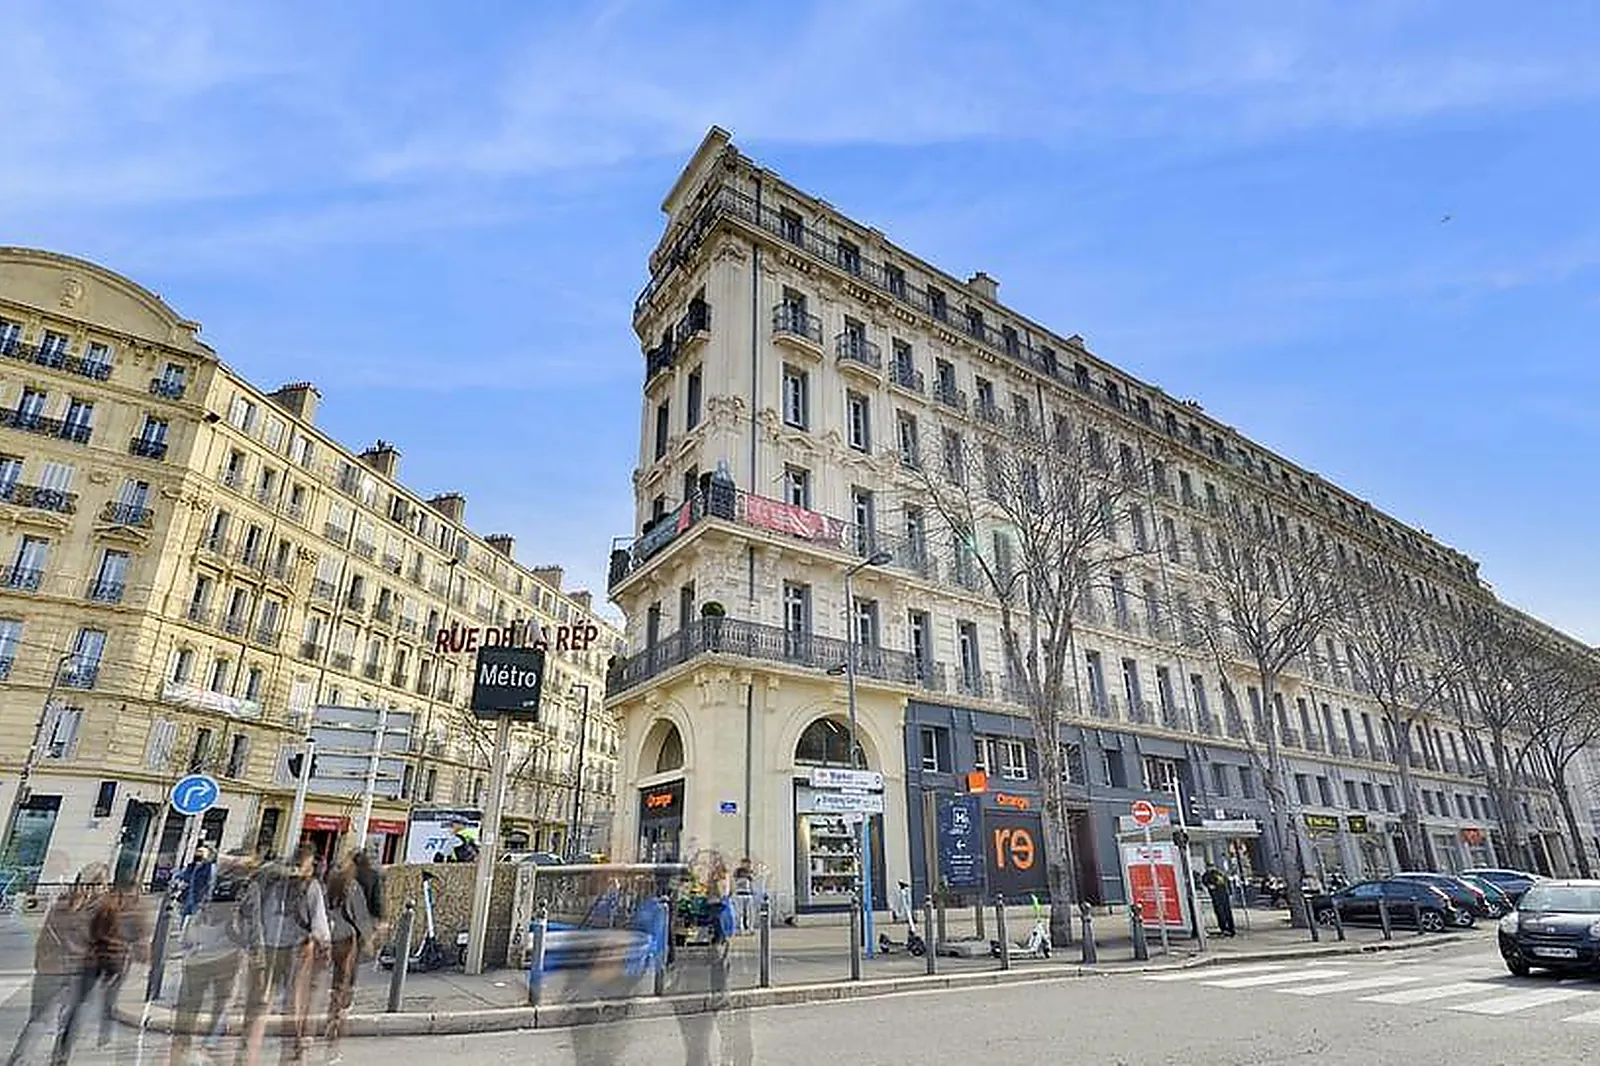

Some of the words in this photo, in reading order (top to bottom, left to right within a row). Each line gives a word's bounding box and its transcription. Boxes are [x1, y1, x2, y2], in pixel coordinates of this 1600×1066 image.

[435, 627, 479, 653] RUE
[556, 619, 598, 651] RÉP
[479, 664, 537, 688] Métro
